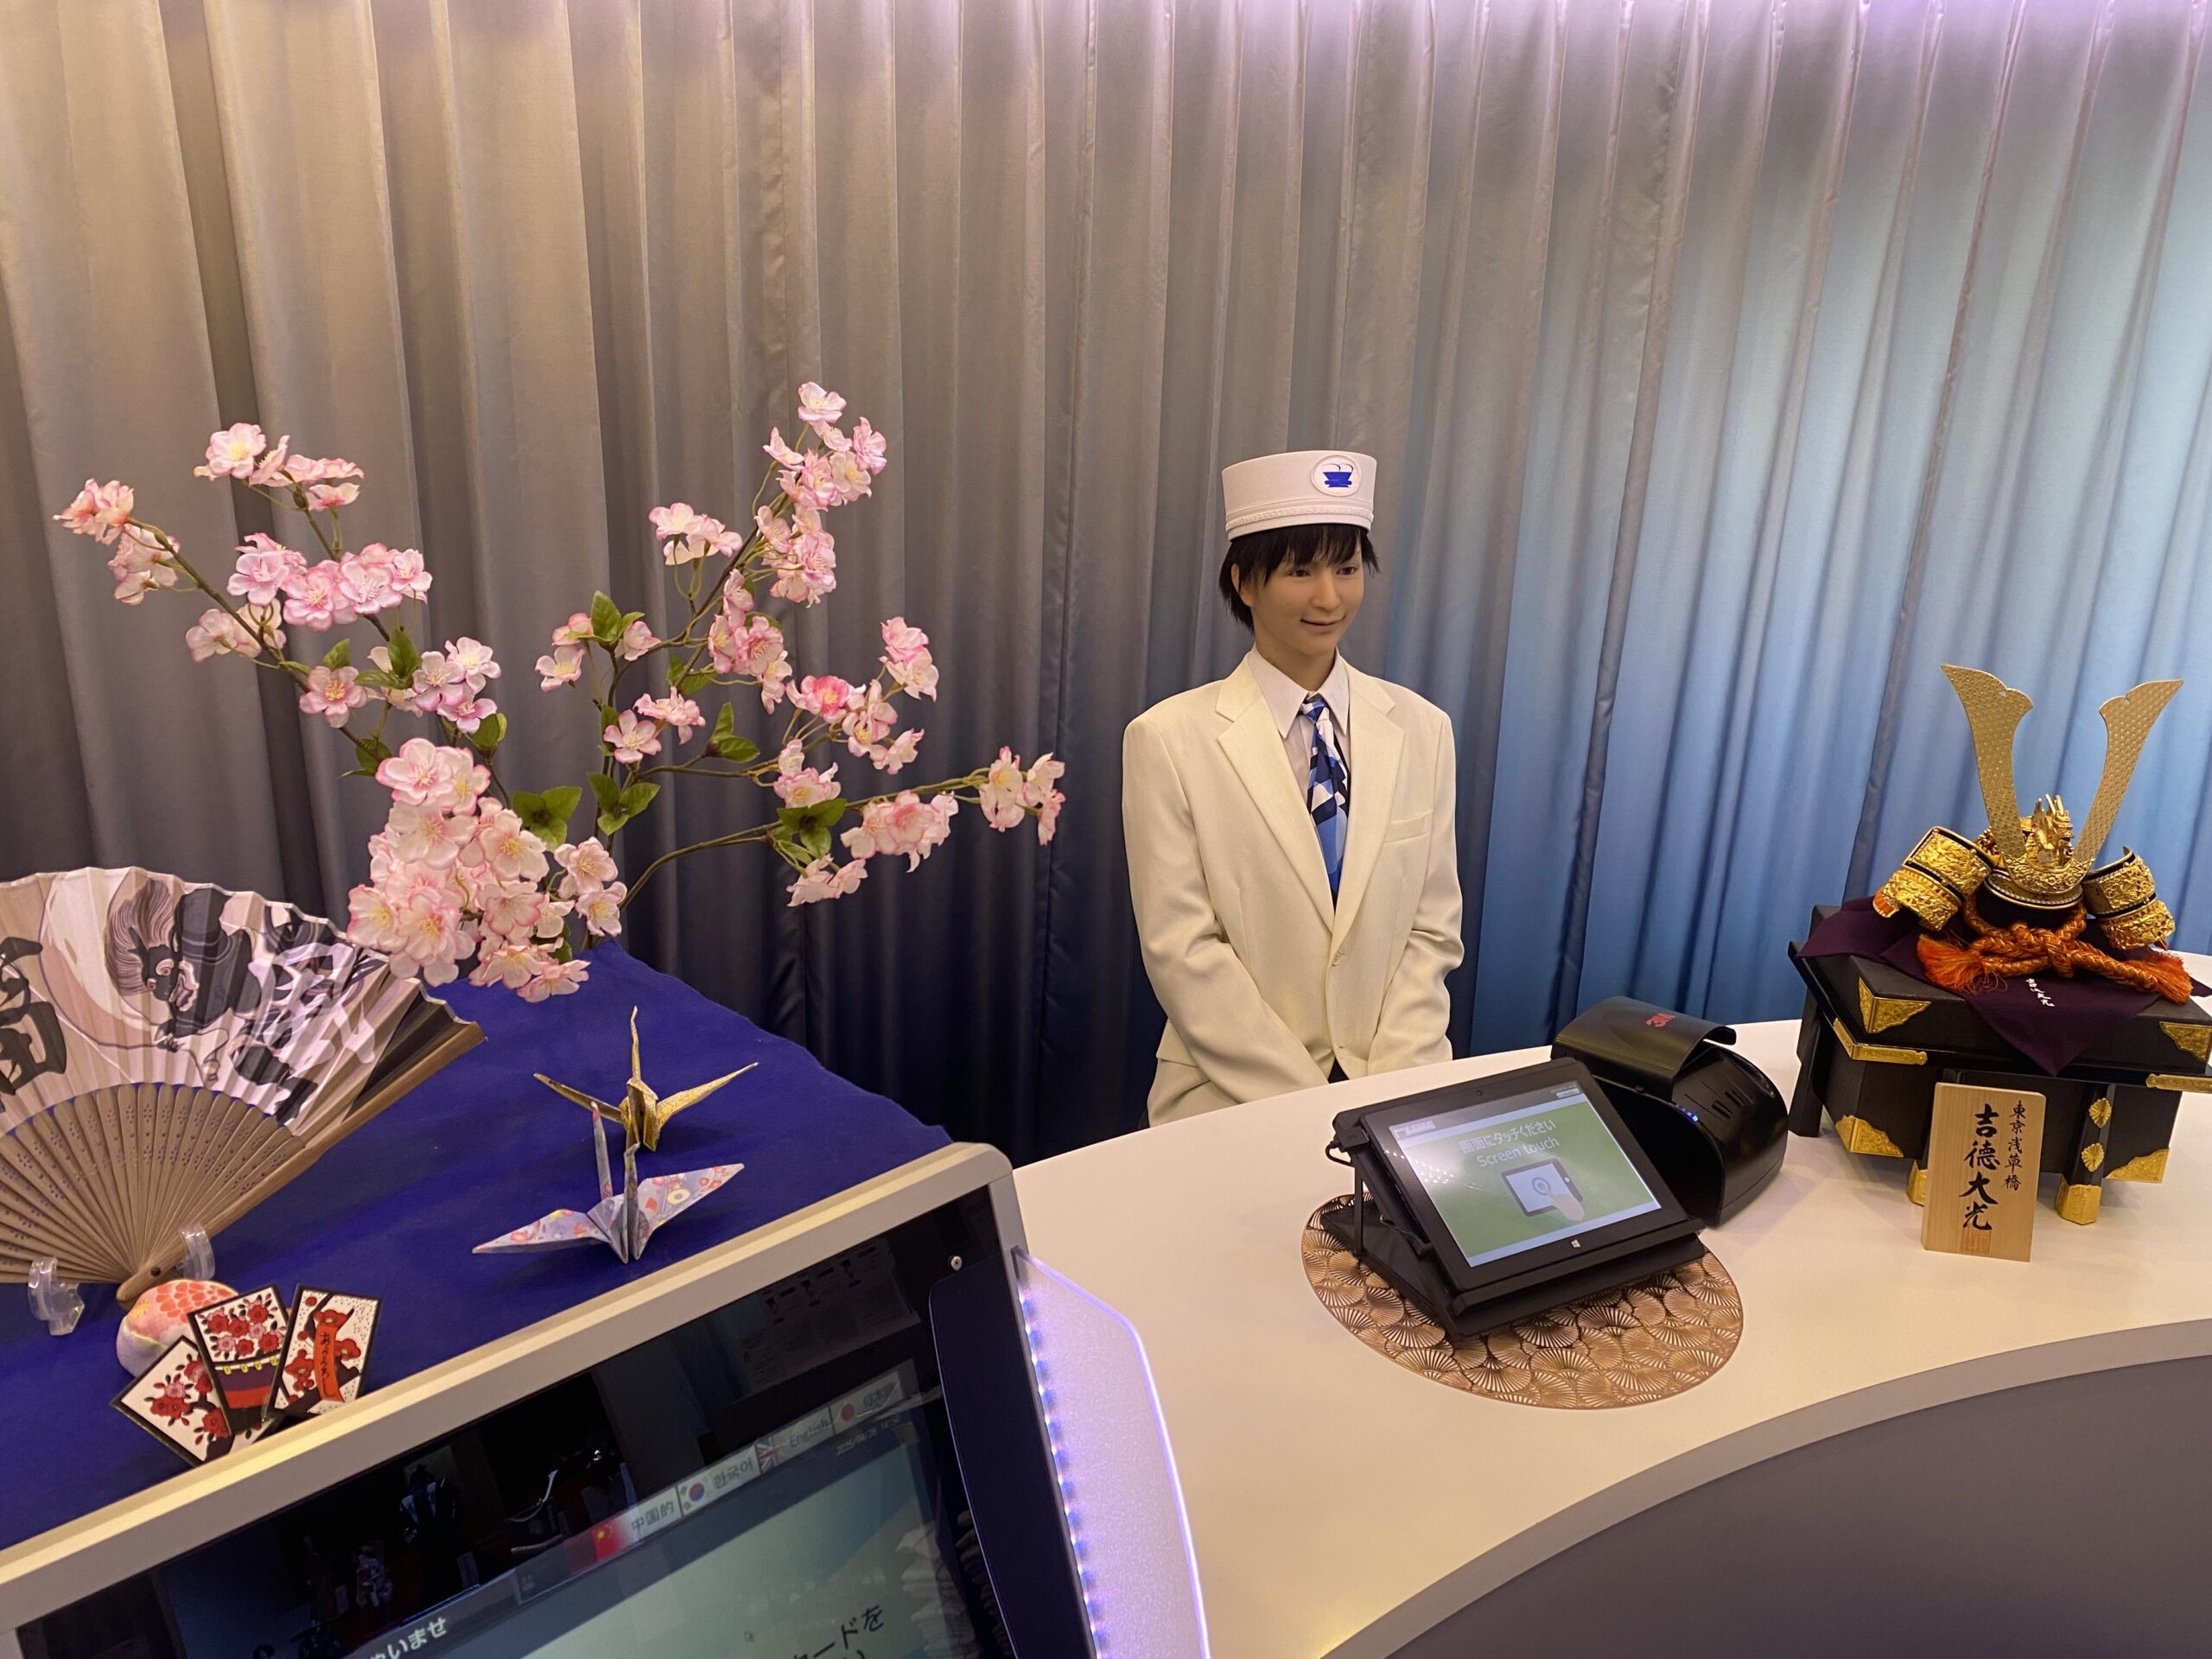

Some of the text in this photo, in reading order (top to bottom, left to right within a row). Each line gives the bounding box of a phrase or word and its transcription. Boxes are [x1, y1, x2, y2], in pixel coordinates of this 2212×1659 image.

[1459, 1118, 1556, 1154] 画面にタッチください
[1477, 1136, 1560, 1167] Screen touch
[2001, 1099, 2027, 1192] 東京浅草橋
[790, 1419, 830, 1448] English
[713, 1455, 754, 1489] 한국어
[632, 1500, 675, 1532] 中国的
[793, 1606, 884, 1659] ードを
